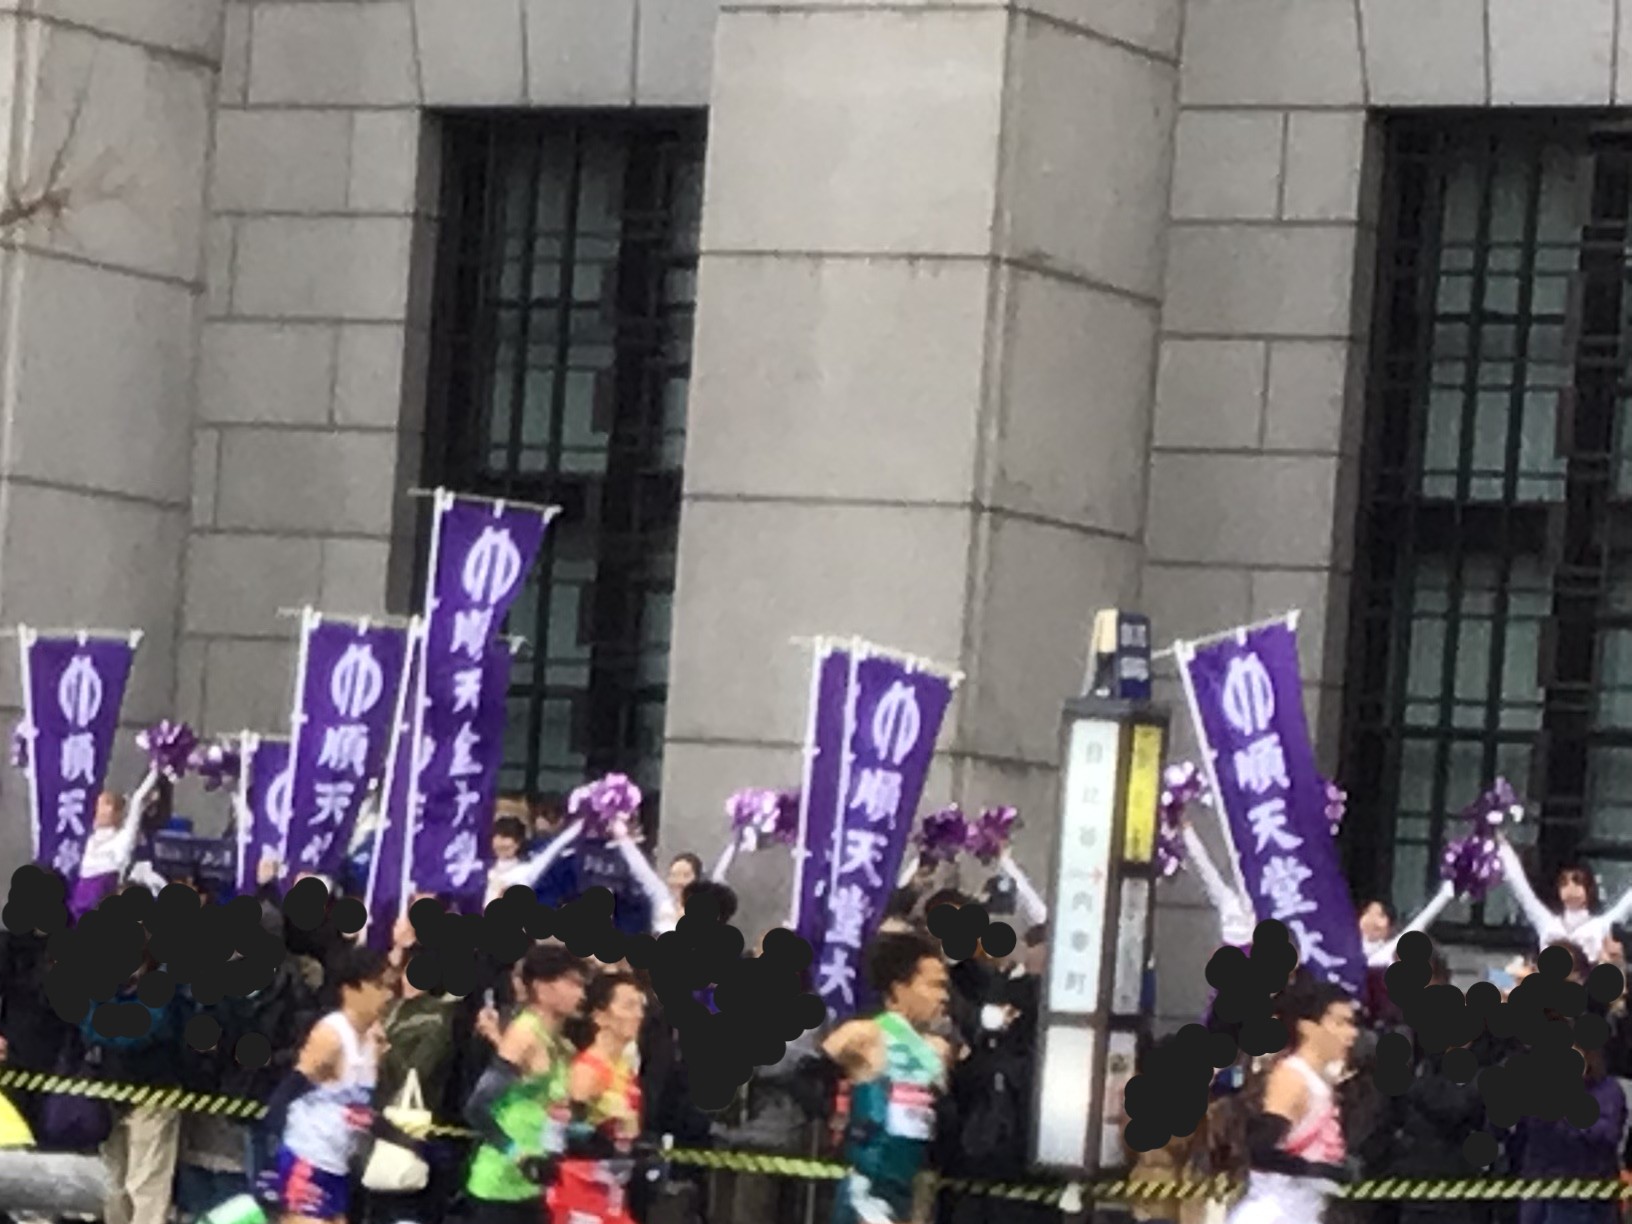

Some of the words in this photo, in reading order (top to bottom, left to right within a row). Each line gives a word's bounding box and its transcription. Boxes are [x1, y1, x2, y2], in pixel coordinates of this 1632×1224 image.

[820, 767, 903, 1018] 順天堂大
[1234, 731, 1360, 992] 順天堂大
